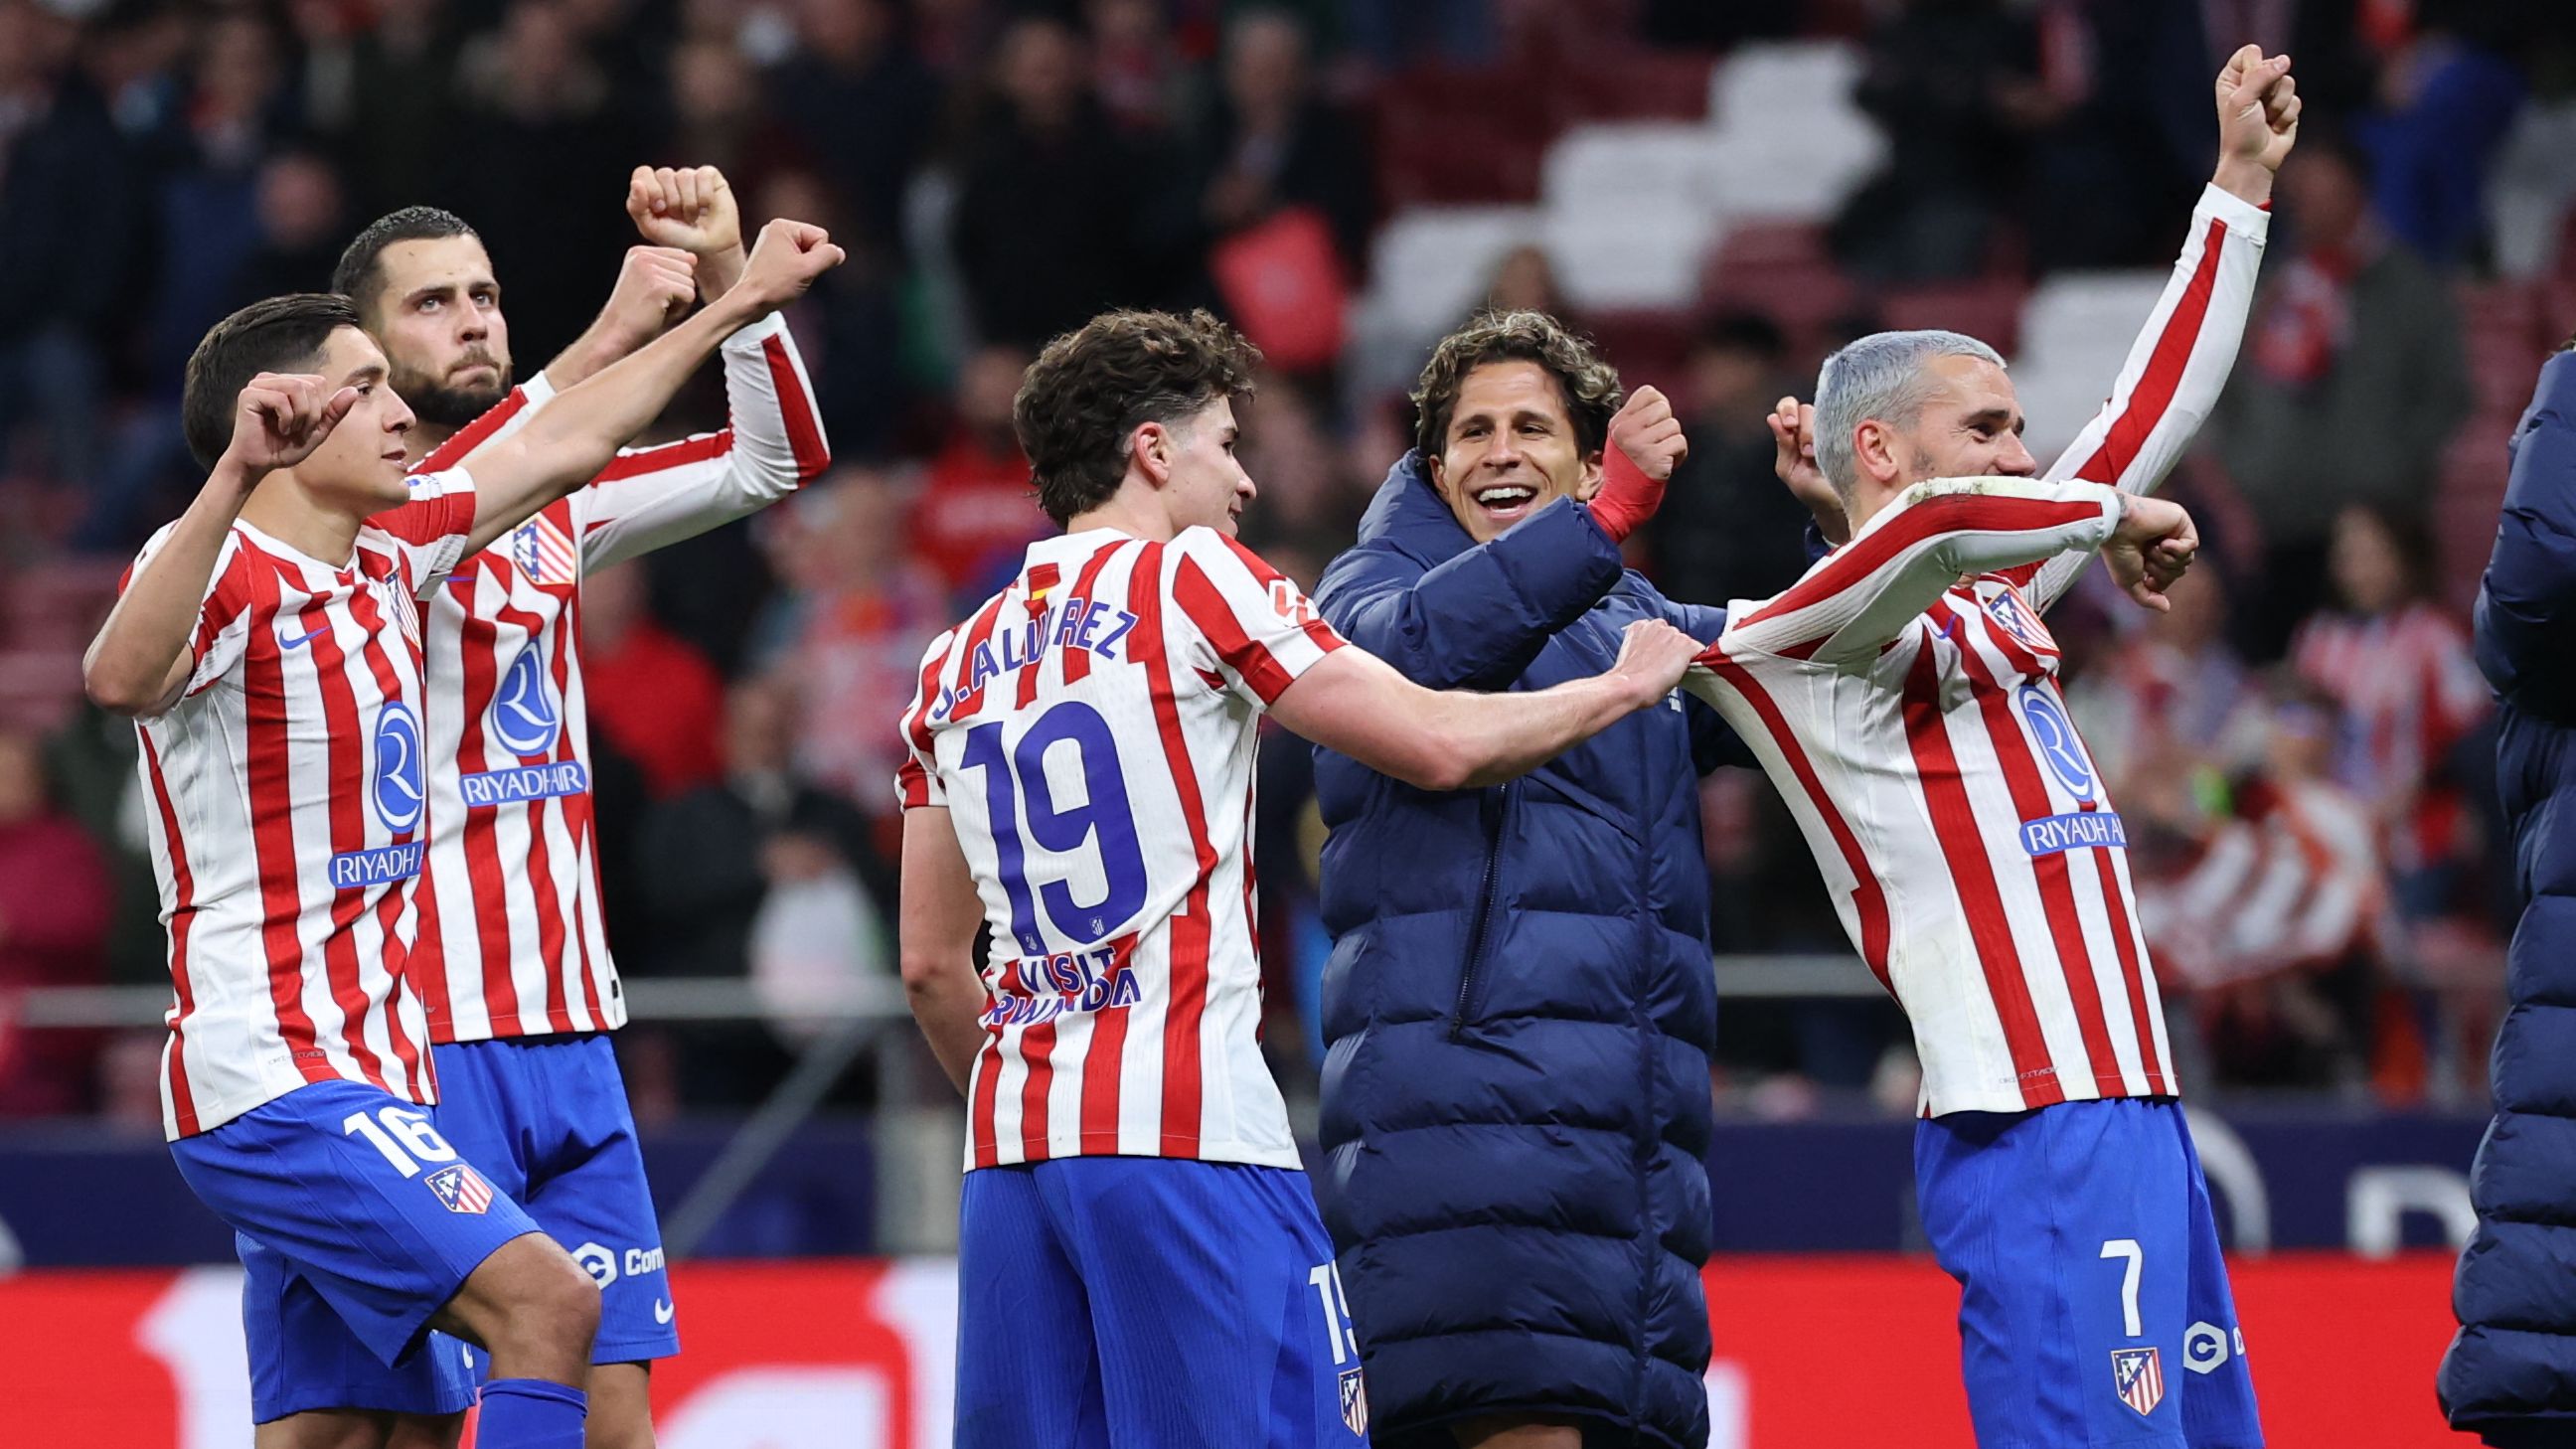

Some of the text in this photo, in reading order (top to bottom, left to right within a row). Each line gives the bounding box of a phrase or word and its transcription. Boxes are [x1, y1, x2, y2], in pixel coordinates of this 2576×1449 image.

[959, 701, 1148, 957] 19
[2026, 817, 2110, 852] RIYADH
[336, 846, 416, 885] RIYADH
[1019, 947, 1115, 993] VISIT
[343, 1106, 457, 1179] 16
[2099, 1238, 2144, 1337] 7
